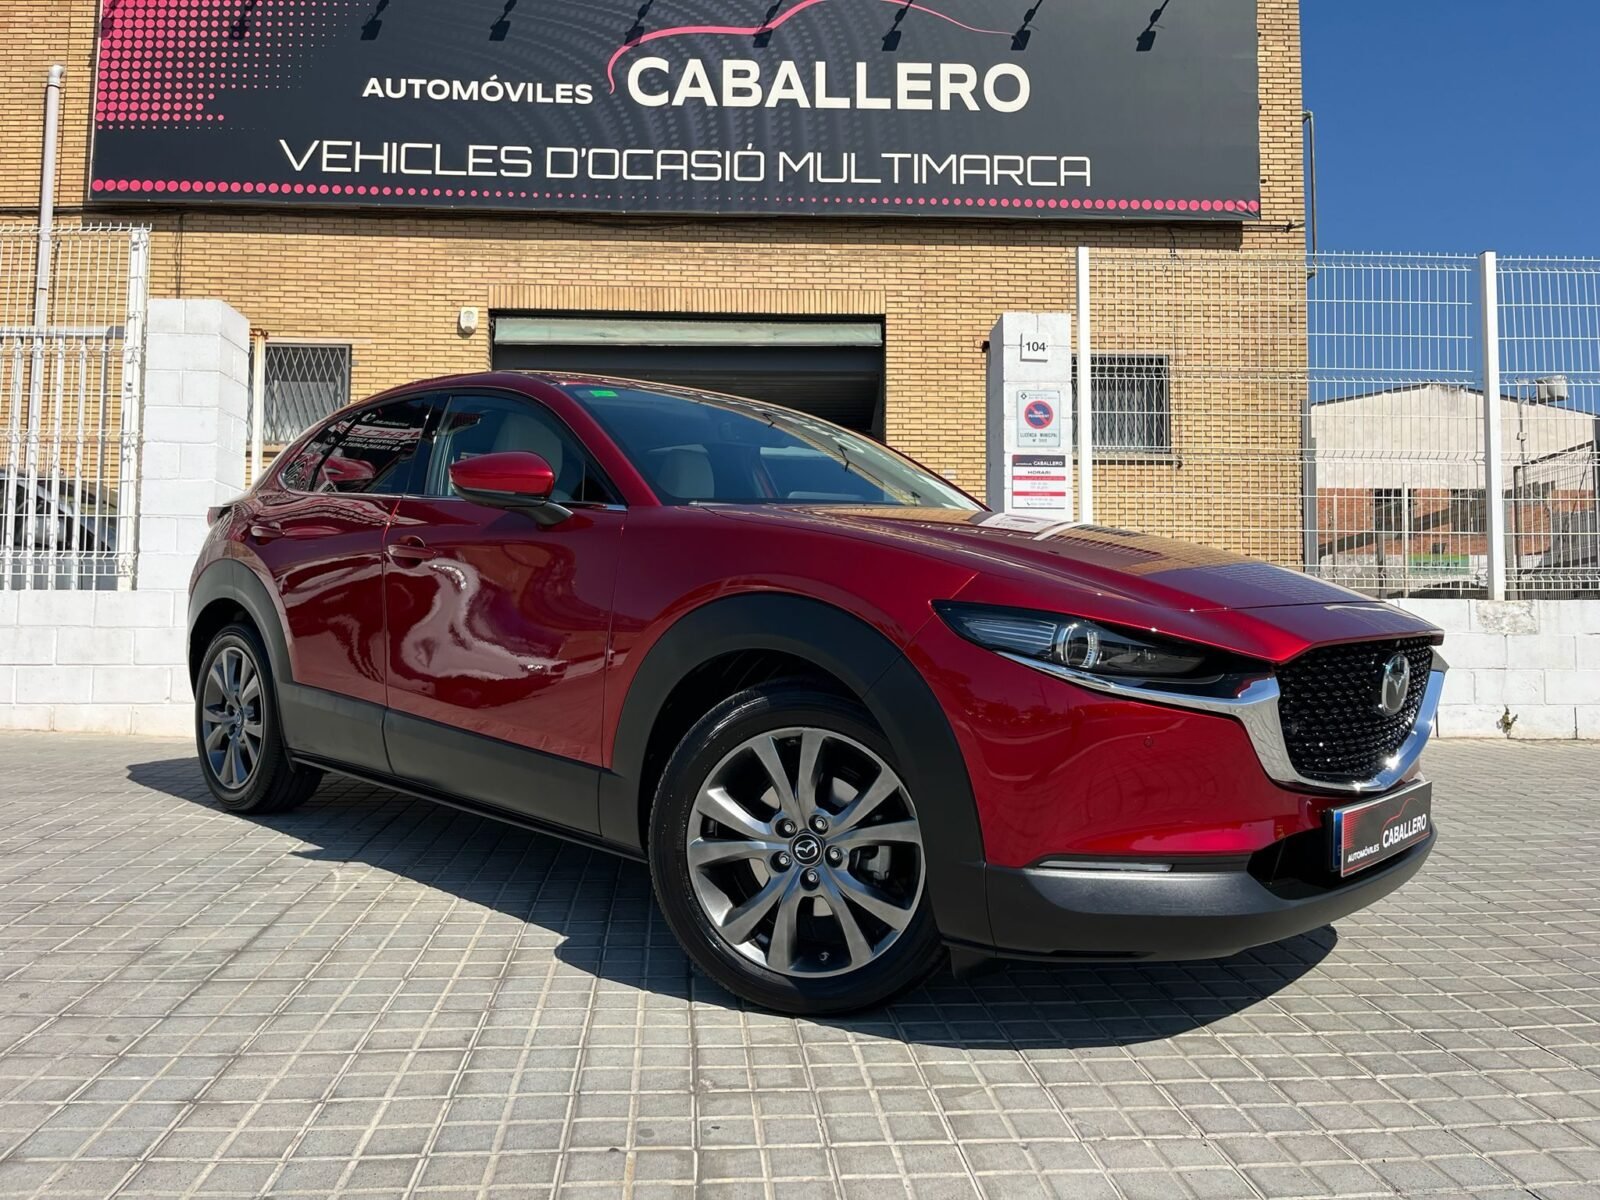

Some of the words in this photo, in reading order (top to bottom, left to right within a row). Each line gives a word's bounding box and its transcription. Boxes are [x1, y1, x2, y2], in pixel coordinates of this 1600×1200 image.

[362, 75, 593, 105] AUTOMÓVILES
[627, 56, 1031, 113] CABALLERO
[279, 139, 533, 178] VEHICLES
[546, 142, 765, 182] D'OCASIÓ
[778, 151, 1092, 187] MULTIMARCA
[1025, 341, 1047, 352] 104
[1347, 843, 1380, 863] AUTOMÓVILES
[1383, 813, 1427, 849] CABALLERO
